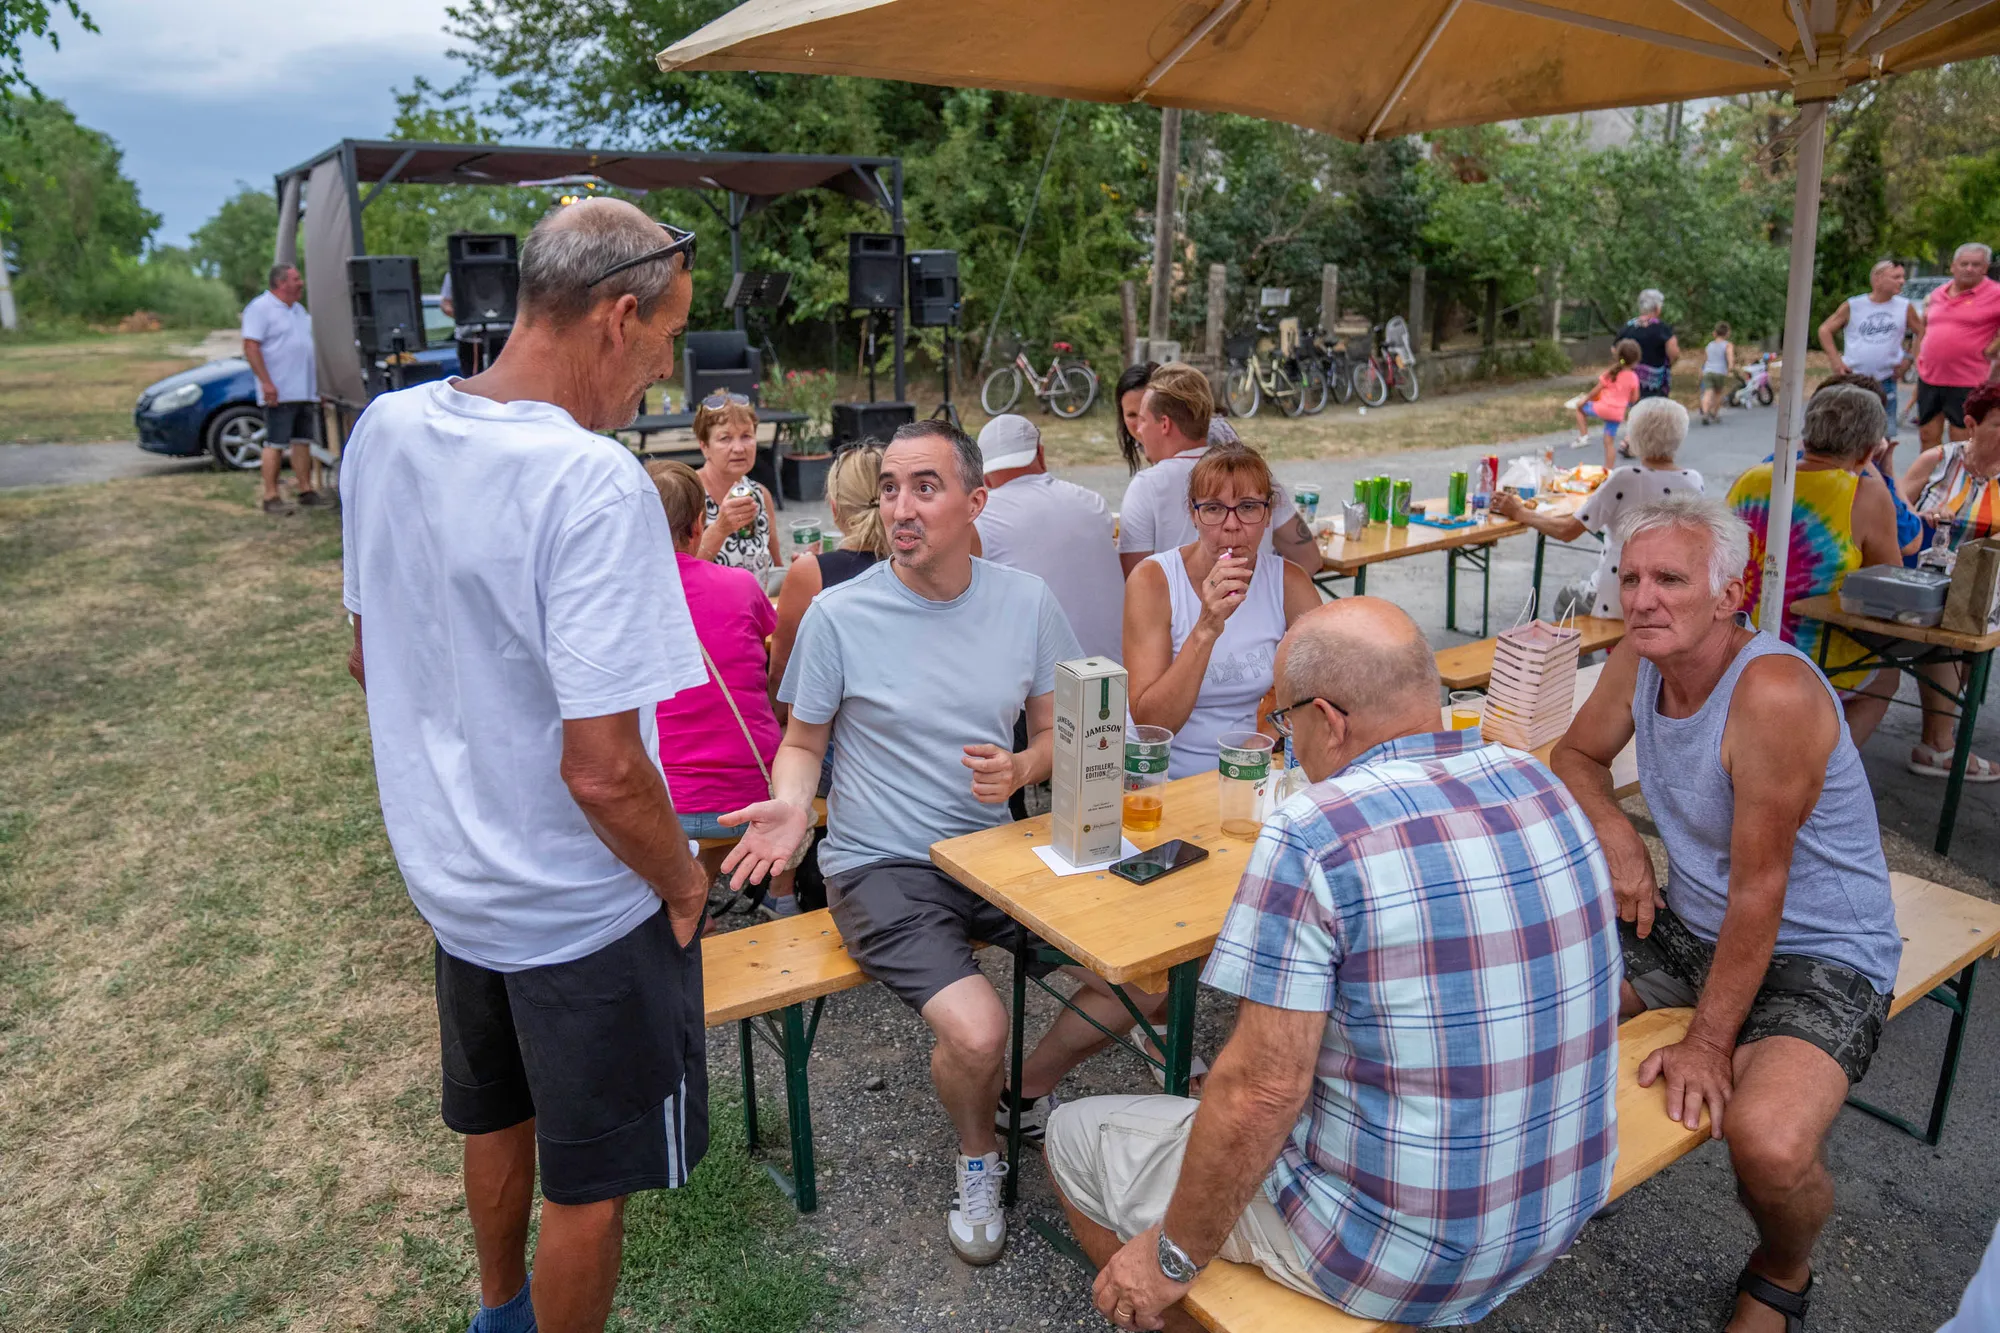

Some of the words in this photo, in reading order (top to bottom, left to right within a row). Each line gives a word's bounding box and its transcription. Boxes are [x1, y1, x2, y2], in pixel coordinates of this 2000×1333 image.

[1057, 715, 1075, 732] JAMESON
[1085, 724, 1122, 738] JAMESON
[1085, 762, 1114, 772] DISTILLERY
[1085, 770, 1106, 779] EDITION
